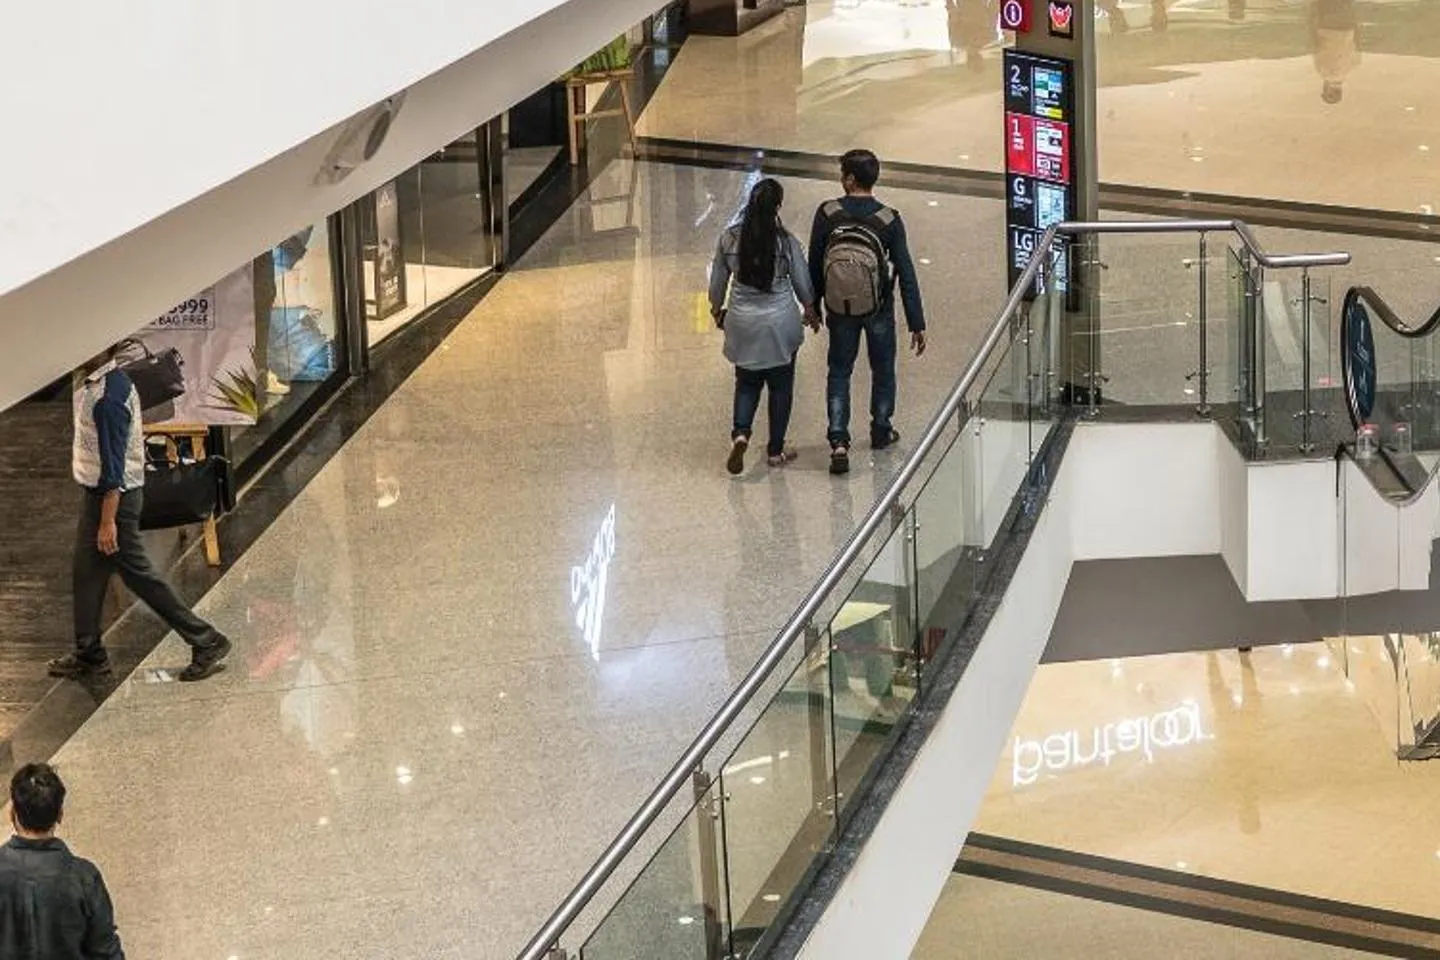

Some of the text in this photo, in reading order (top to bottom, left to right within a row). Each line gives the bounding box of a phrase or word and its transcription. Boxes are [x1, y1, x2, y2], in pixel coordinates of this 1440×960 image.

[1010, 64, 1021, 84] 2
[1013, 177, 1025, 195] G
[1014, 231, 1034, 253] LG
